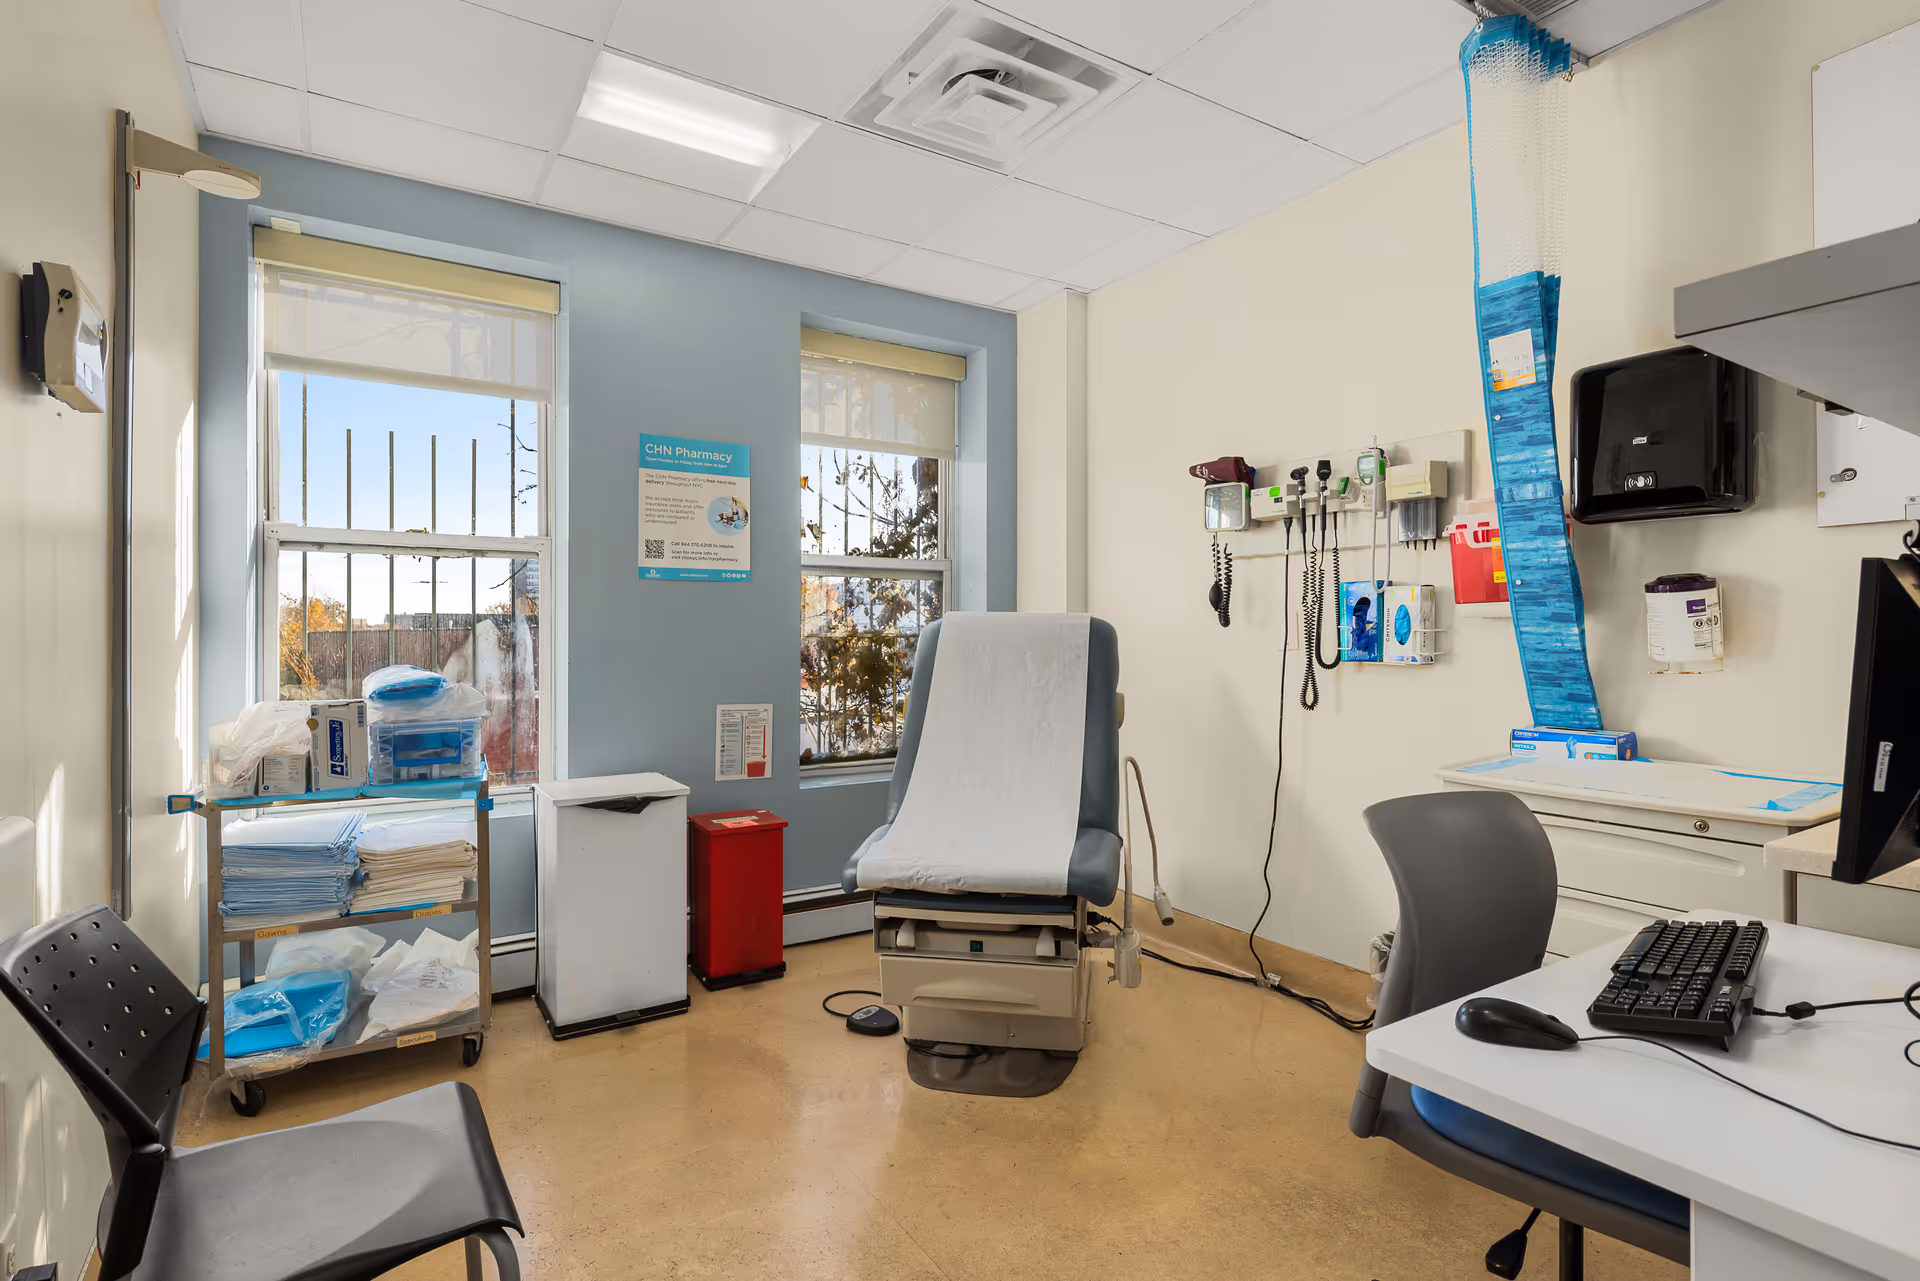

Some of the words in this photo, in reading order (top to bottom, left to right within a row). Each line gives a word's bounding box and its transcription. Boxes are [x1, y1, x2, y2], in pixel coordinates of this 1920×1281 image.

[645, 443, 672, 456] CHN
[675, 446, 733, 464] Pharmacy
[668, 474, 691, 482] Pharmacy
[415, 909, 443, 919] Drapes
[257, 929, 287, 939] Gowns
